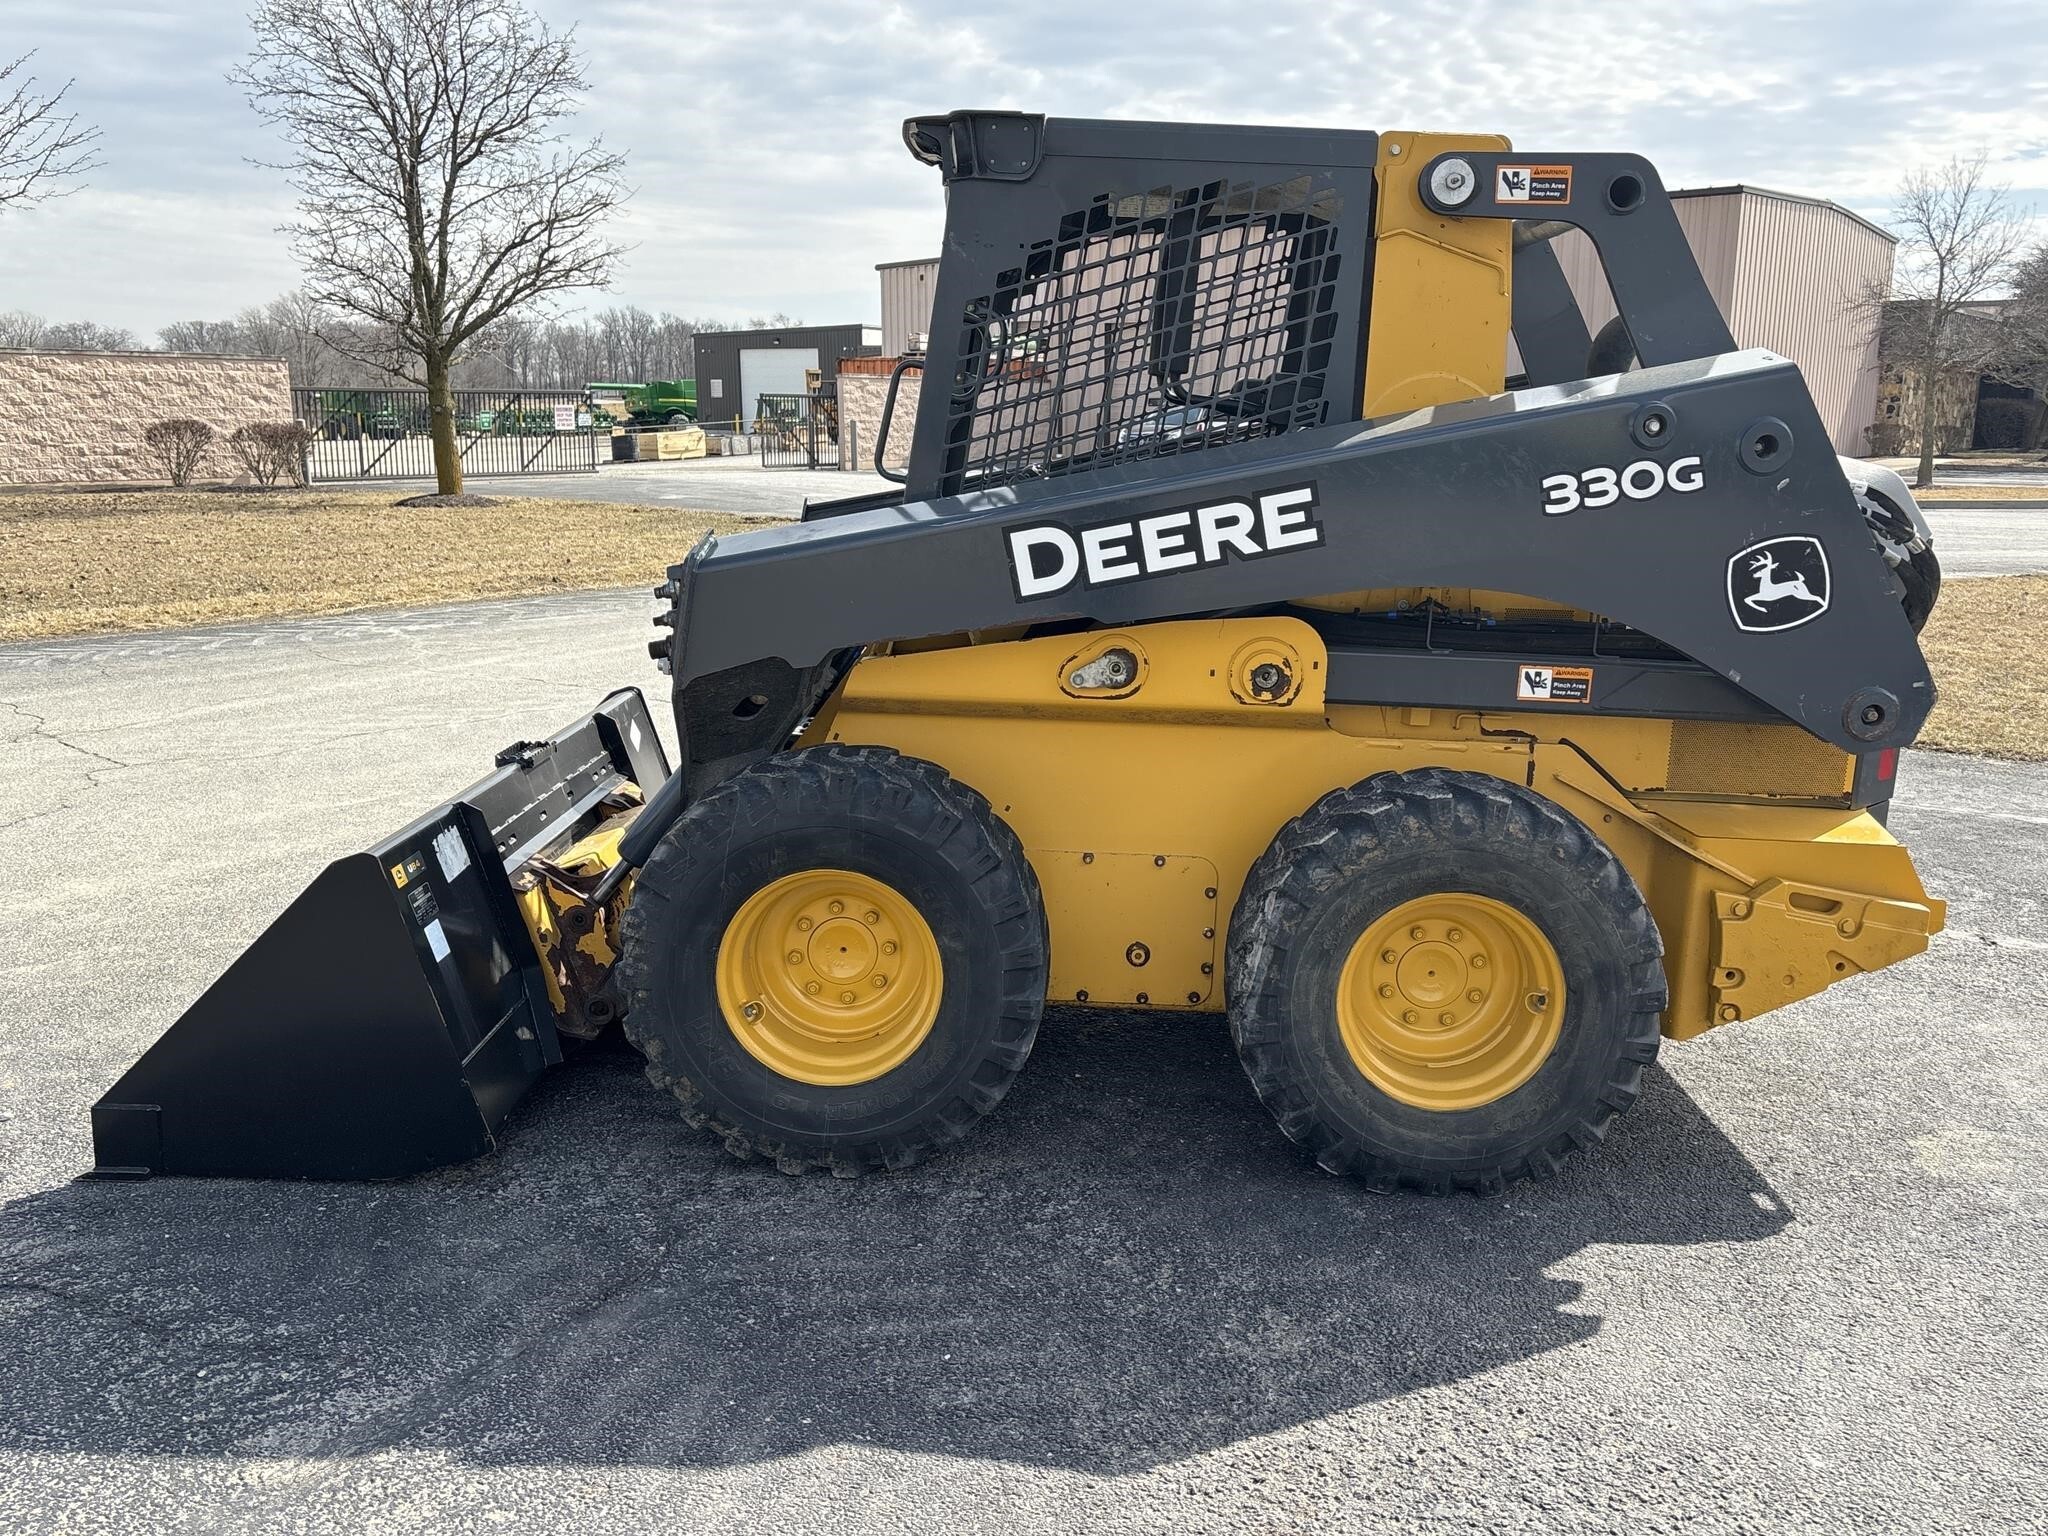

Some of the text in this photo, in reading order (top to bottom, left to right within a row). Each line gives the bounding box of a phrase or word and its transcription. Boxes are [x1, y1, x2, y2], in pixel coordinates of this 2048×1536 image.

[1540, 168, 1568, 176] WARNING
[1542, 456, 1704, 514] 330G
[1010, 487, 1318, 597] DEERE
[1560, 669, 1589, 677] WARNING
[1553, 681, 1587, 690] Pinch Area
